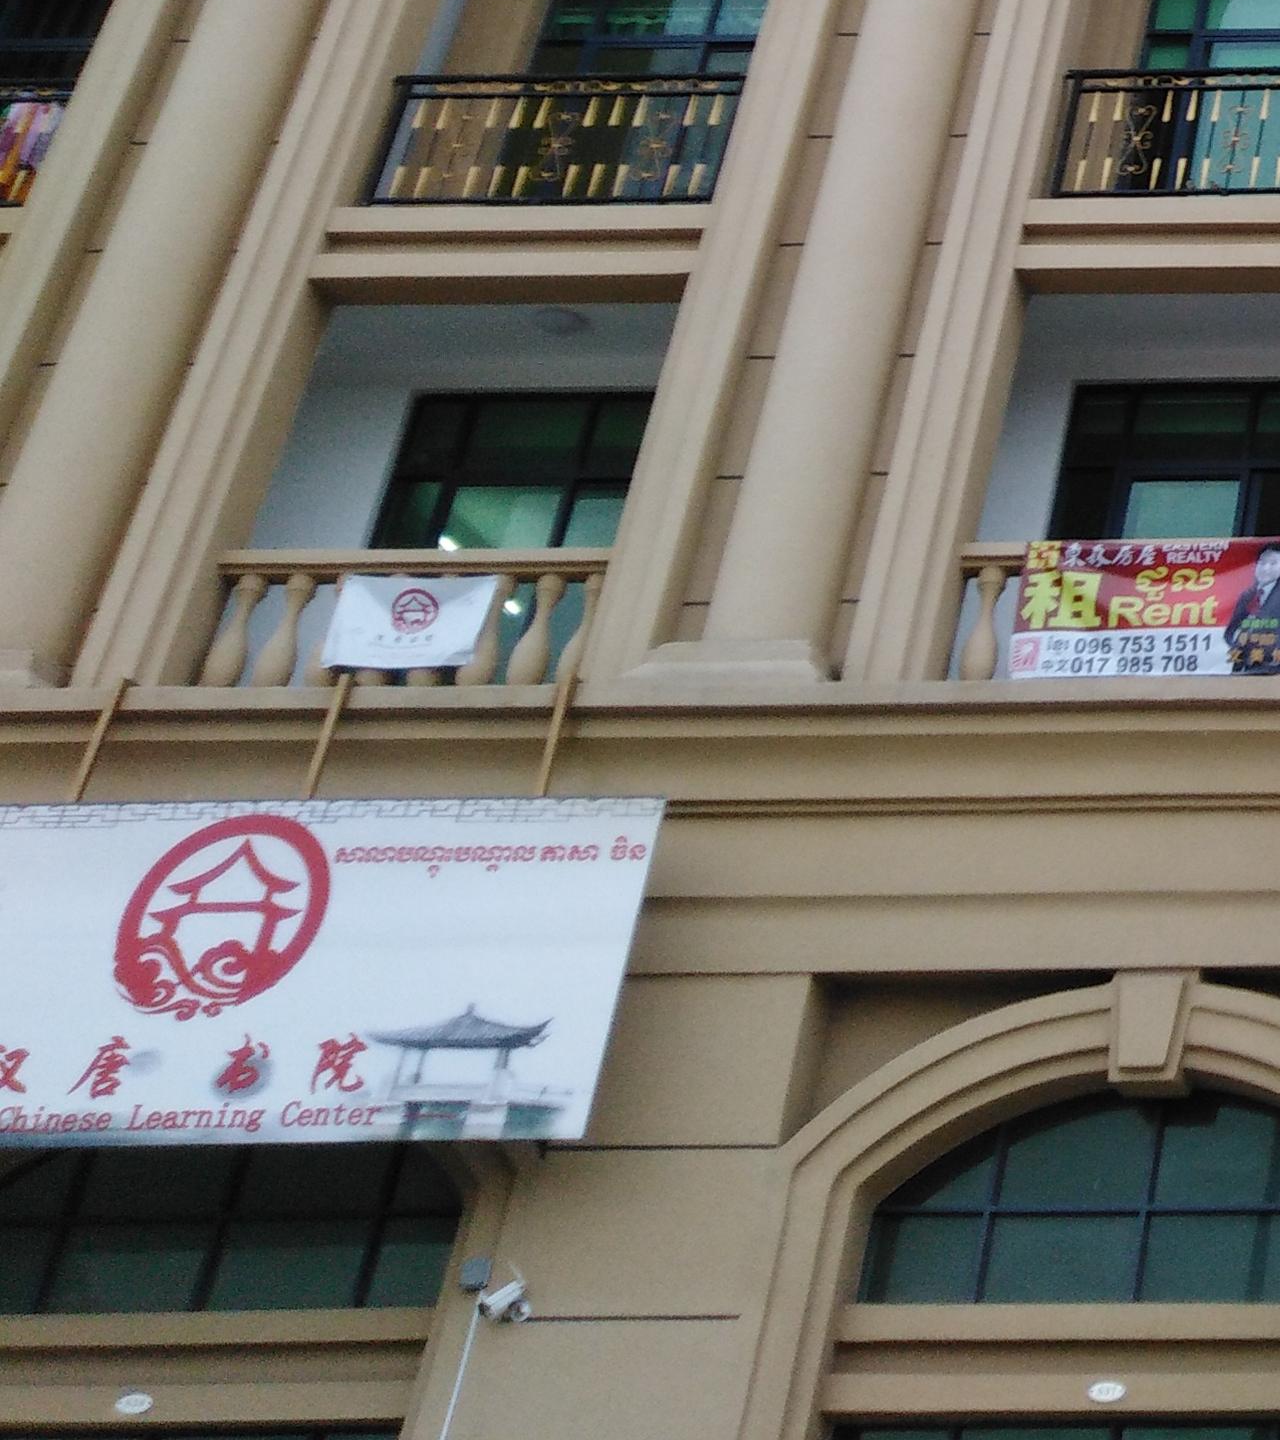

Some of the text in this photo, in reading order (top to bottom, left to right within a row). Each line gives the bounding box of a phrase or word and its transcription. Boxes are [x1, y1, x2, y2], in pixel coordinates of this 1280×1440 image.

[1166, 551, 1222, 564] REALTY
[1021, 569, 1103, 629] 租
[1108, 595, 1219, 628] Rent
[1074, 637, 1112, 655] 096
[1119, 635, 1154, 653] 753
[1163, 634, 1212, 652] 1511
[1070, 657, 1110, 674] 017
[1117, 656, 1154, 674] 985
[1161, 654, 1199, 672] 708
[0, 1100, 382, 1134] Chinese Learning Center
